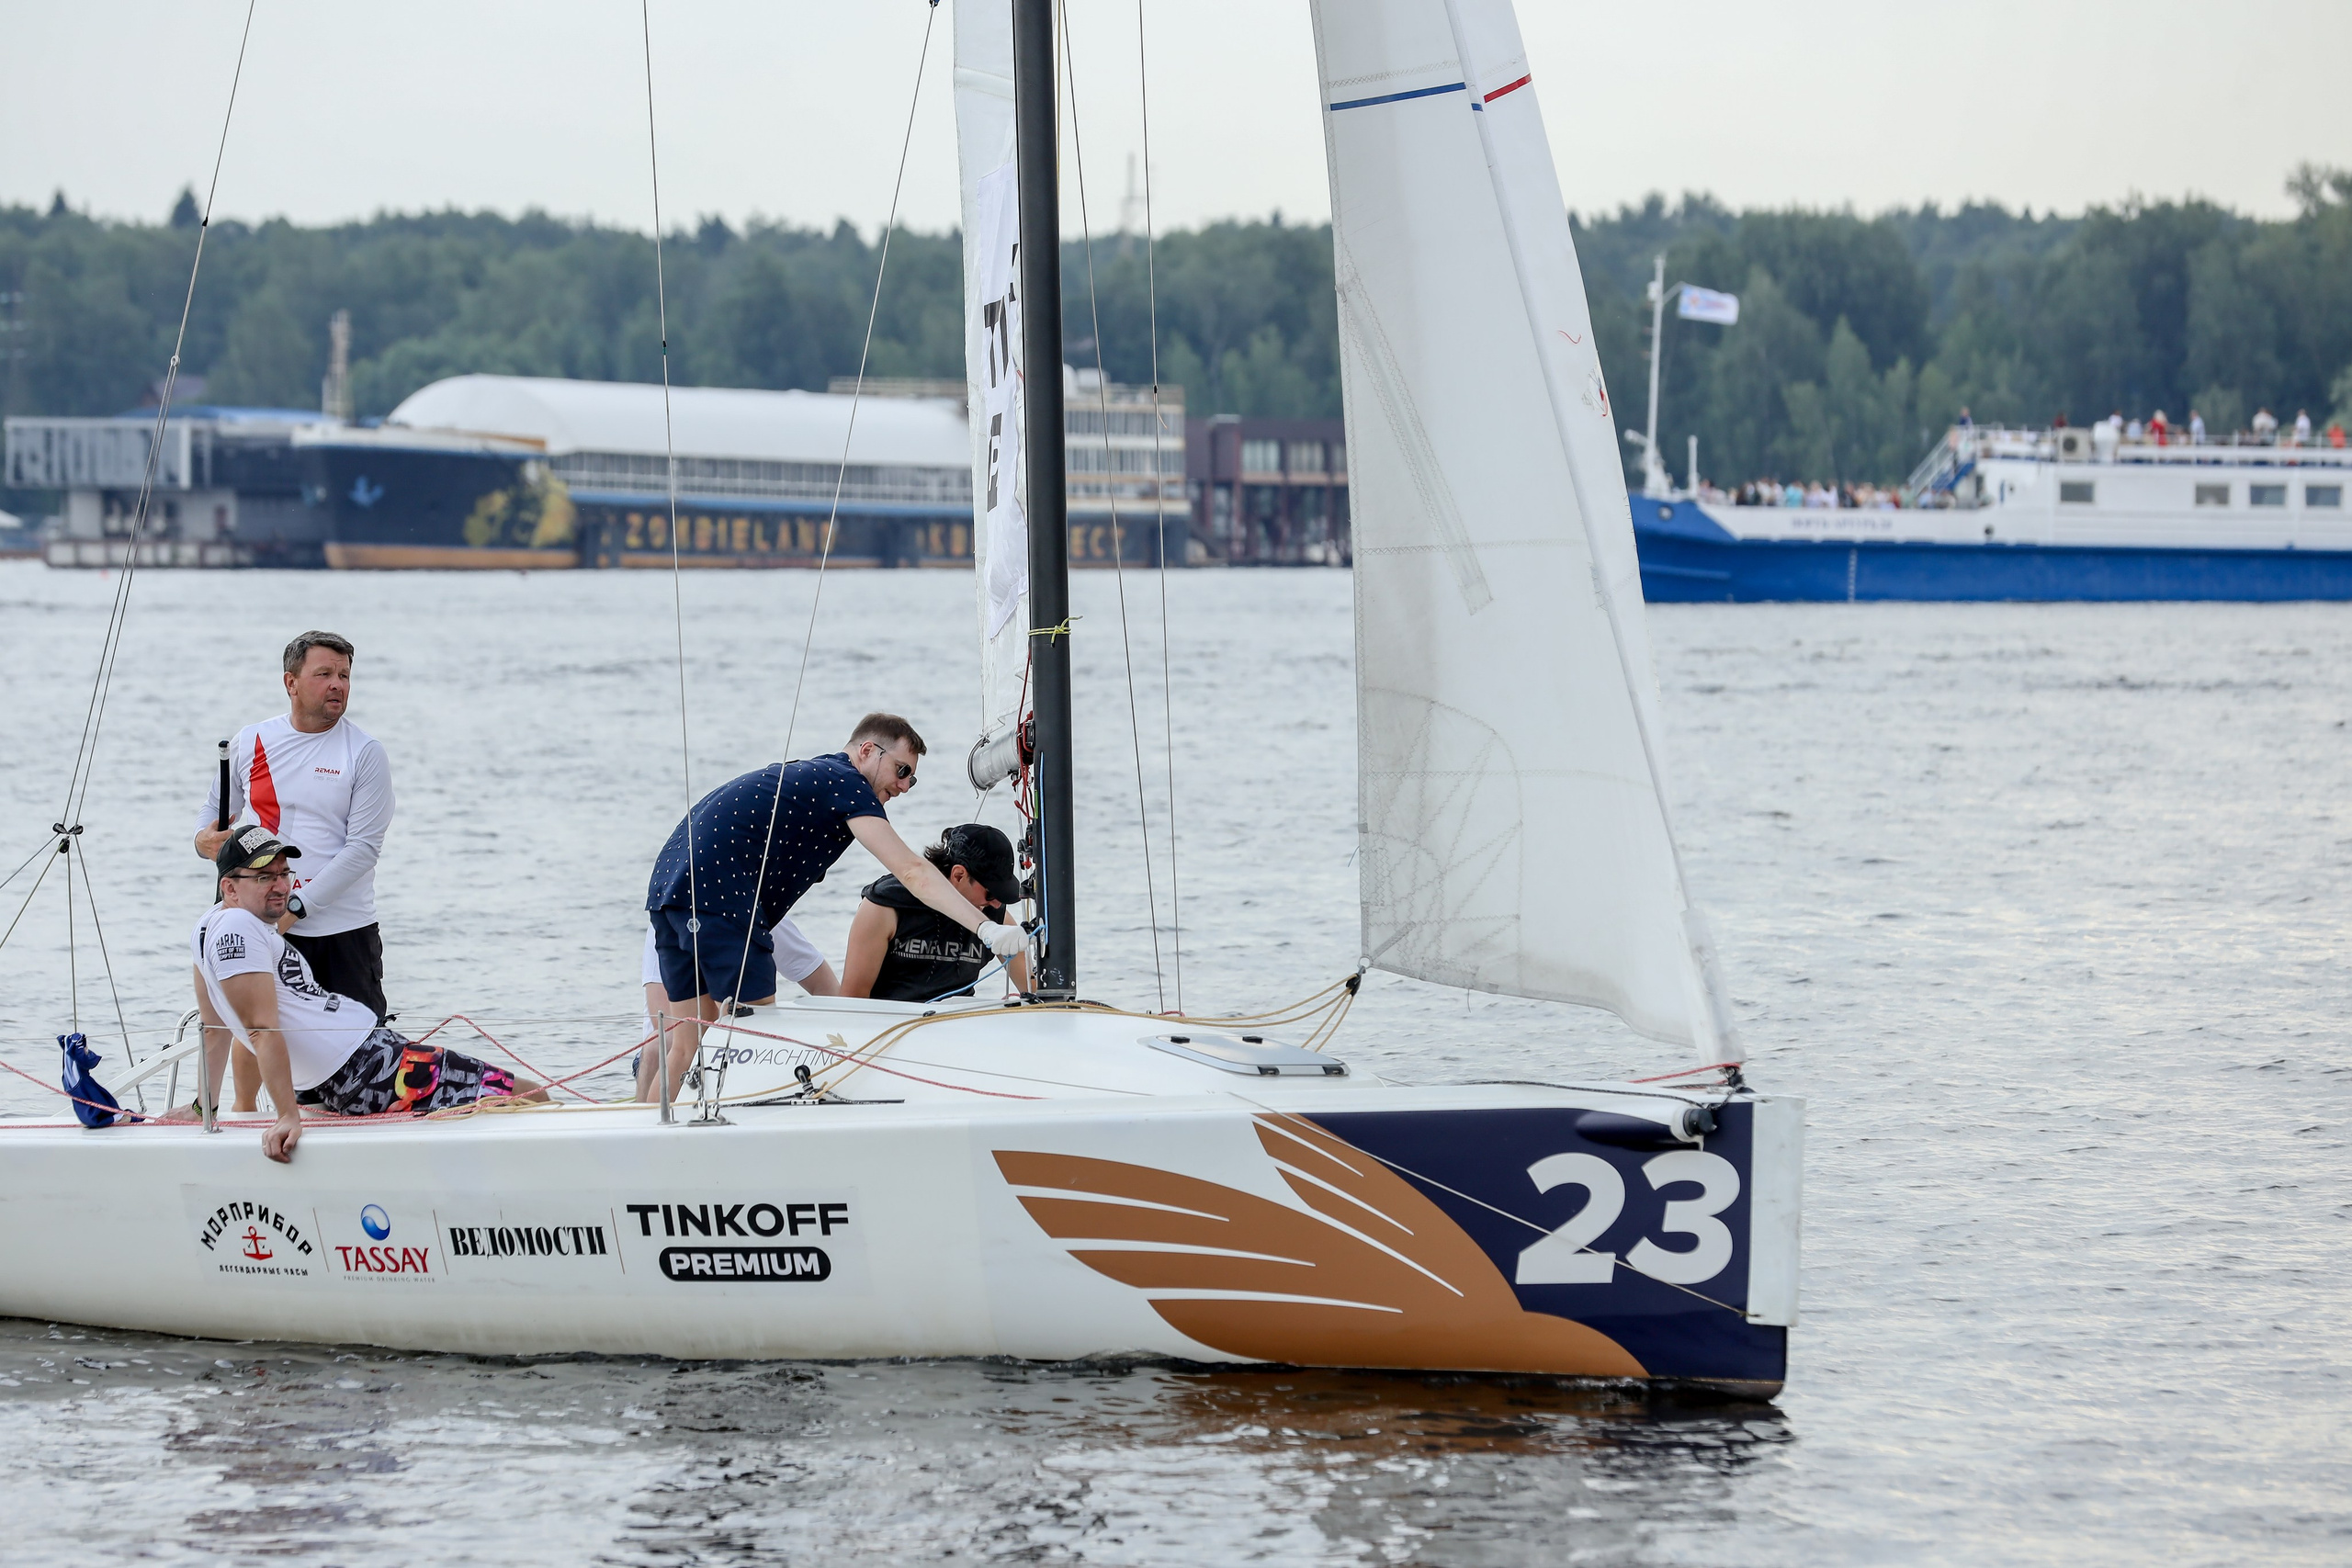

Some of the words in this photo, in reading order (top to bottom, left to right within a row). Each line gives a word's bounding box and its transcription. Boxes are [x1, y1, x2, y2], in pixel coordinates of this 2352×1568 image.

[200, 1201, 313, 1257] МОРПРИБОР
[626, 1202, 850, 1238] TINKOFF
[1515, 1149, 1741, 1285] 23
[449, 1224, 608, 1259] ВЕДОМОСТИ
[283, 1268, 309, 1277] ЧАСЫ
[334, 1246, 430, 1274] TASSAY
[669, 1252, 821, 1277] PREMIUM
